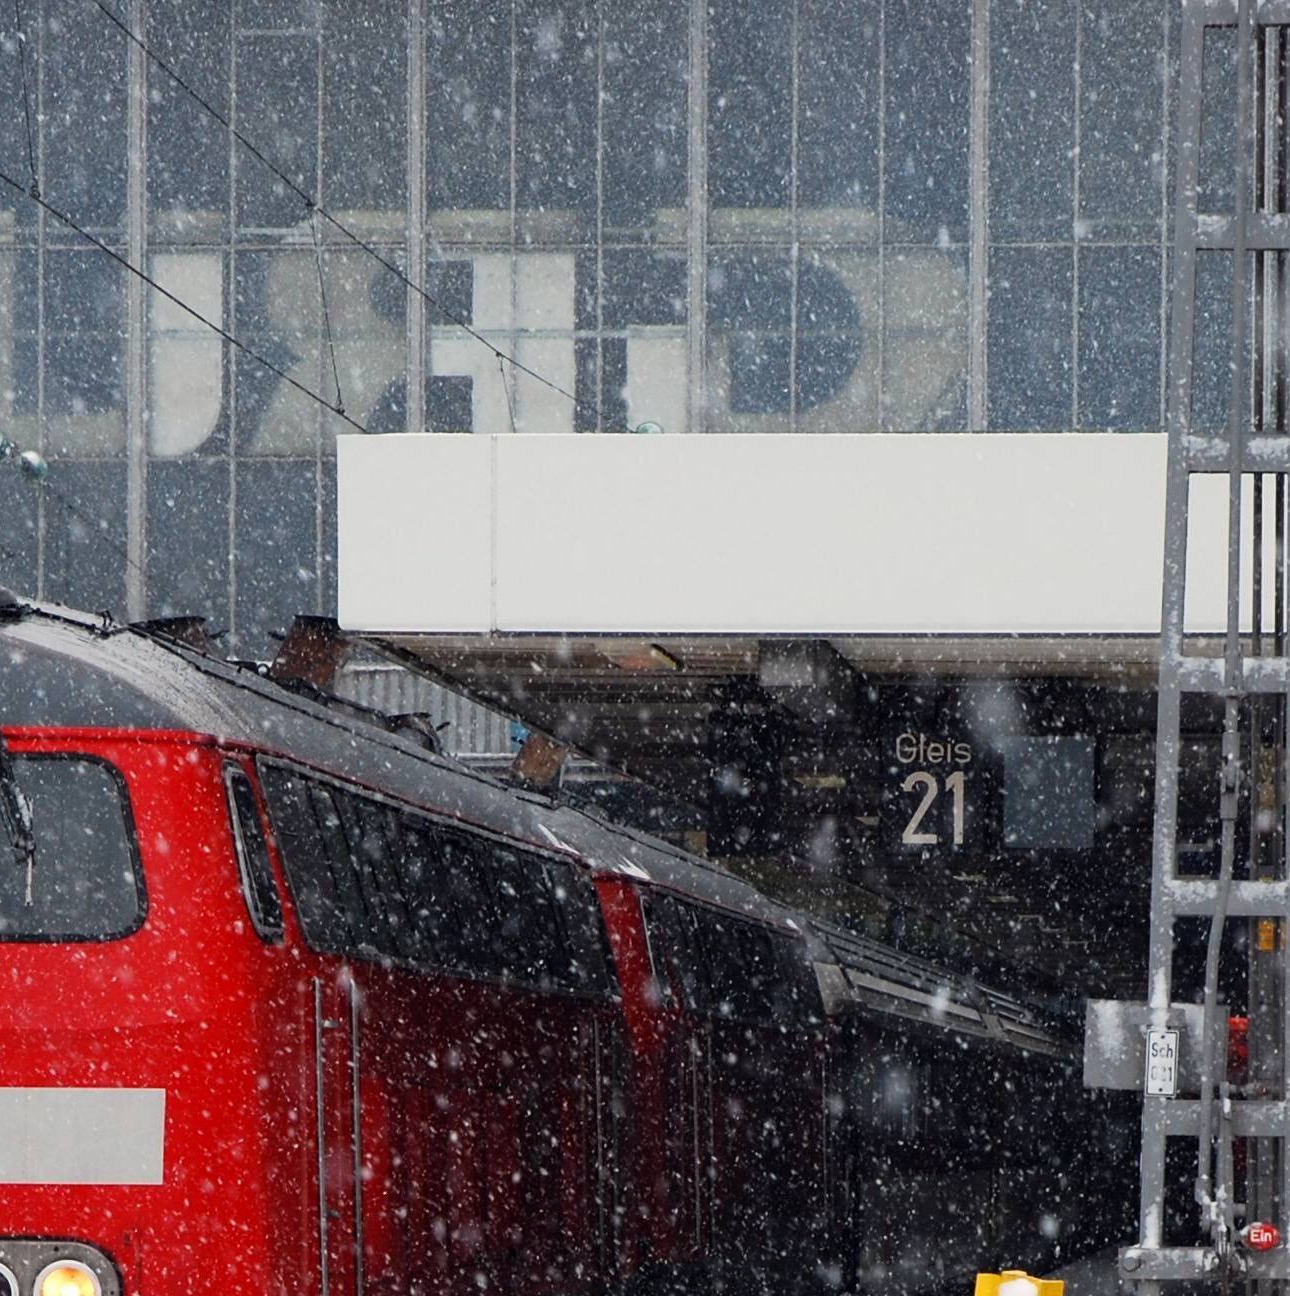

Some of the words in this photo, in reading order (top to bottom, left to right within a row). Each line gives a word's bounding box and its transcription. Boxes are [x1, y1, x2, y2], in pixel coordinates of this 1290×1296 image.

[895, 732, 972, 764] Gleis
[901, 770, 965, 845] 21
[1151, 1042, 1173, 1058] Sch
[1250, 1228, 1273, 1243] Ein
